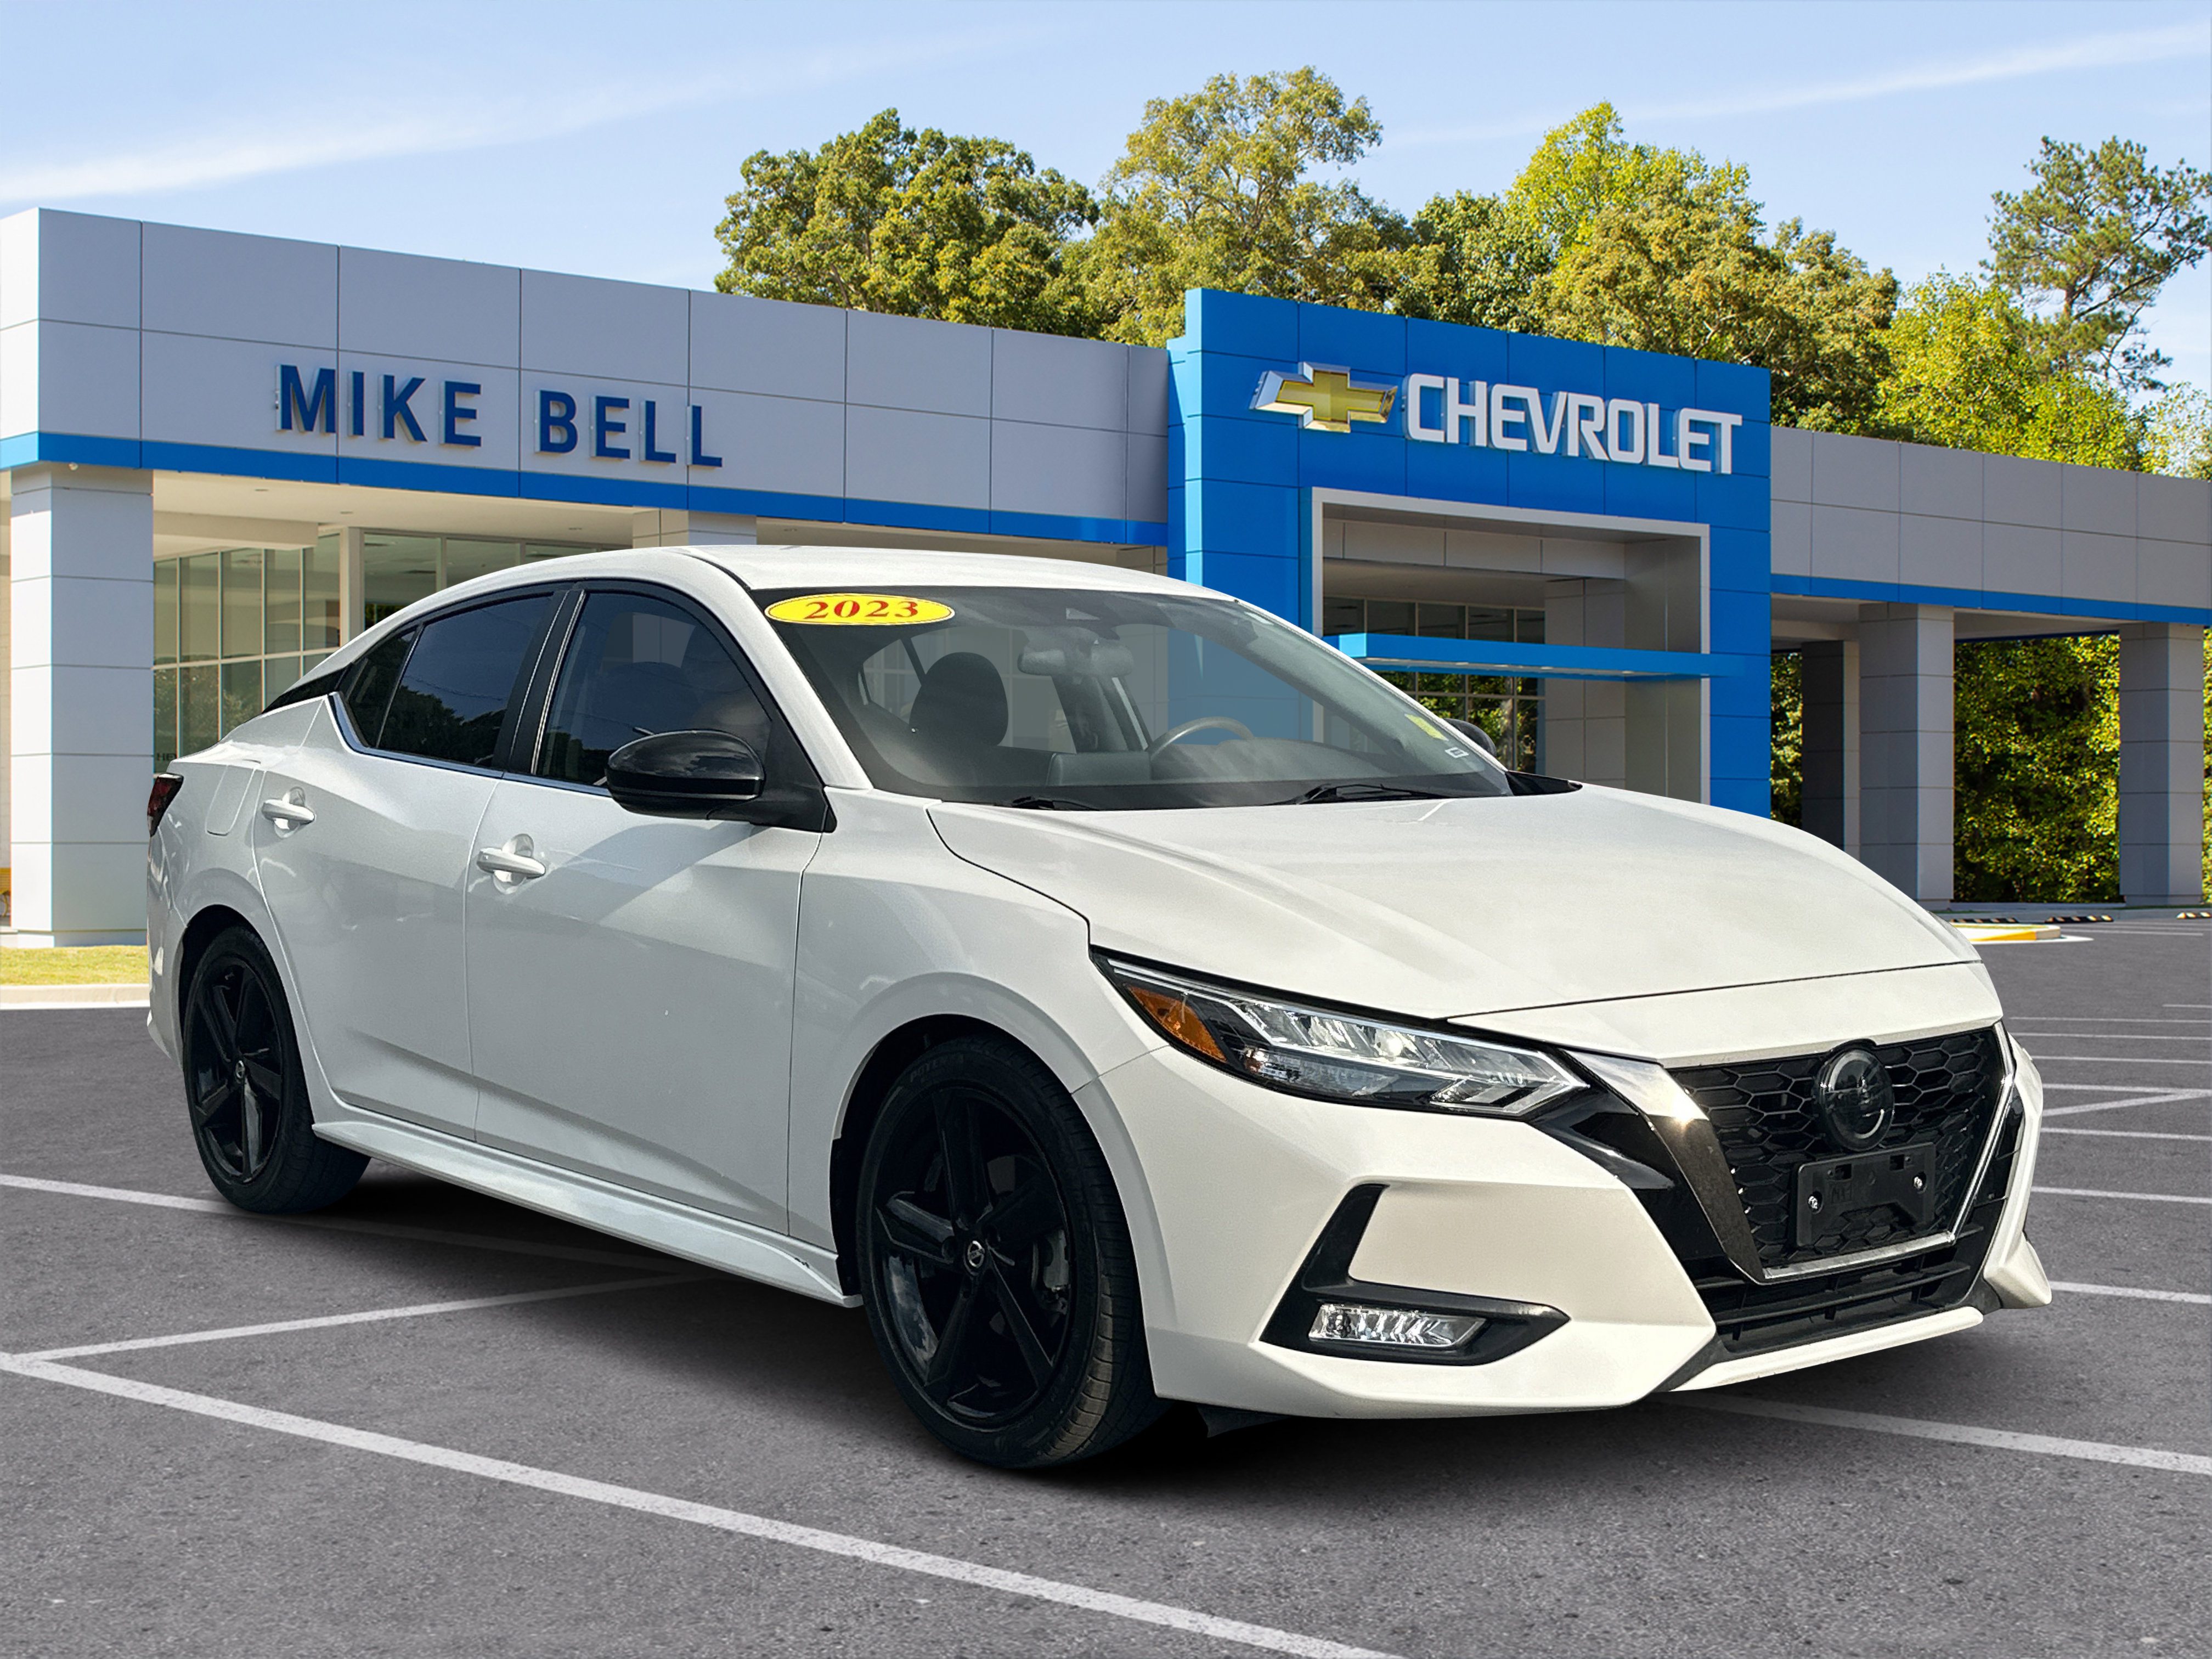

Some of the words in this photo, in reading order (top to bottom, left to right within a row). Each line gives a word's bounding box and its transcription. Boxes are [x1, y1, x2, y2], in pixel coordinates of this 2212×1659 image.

[277, 364, 482, 448] MIKE
[536, 389, 723, 468] BELL
[1404, 373, 1742, 475] CHEVROLET
[803, 600, 919, 619] 2023
